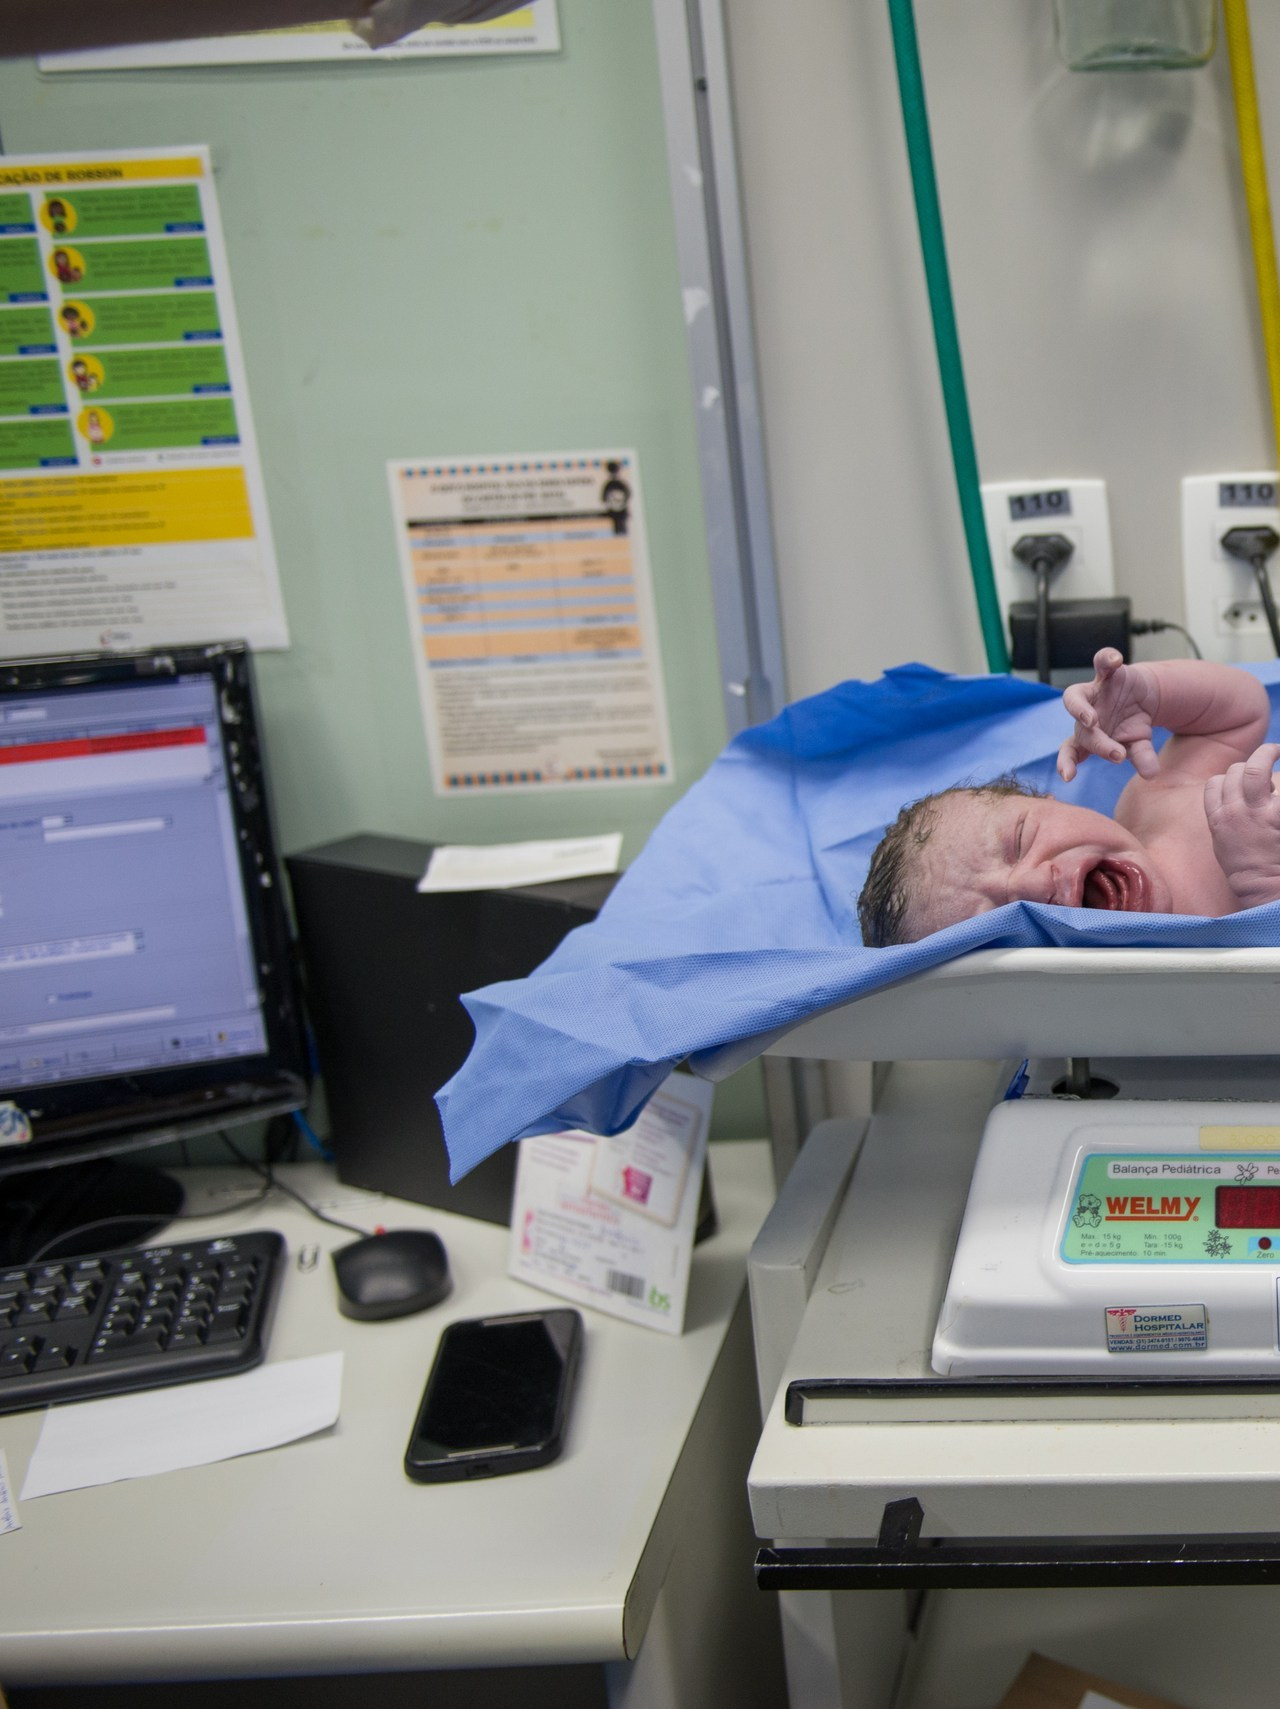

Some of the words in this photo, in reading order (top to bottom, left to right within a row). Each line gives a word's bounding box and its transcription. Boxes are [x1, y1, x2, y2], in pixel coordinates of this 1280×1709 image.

[1226, 482, 1274, 499] 110
[1012, 494, 1063, 513] 110
[1112, 1164, 1159, 1176] Balança
[1161, 1164, 1222, 1175] Pediátrica
[1113, 1233, 1121, 1241] kg
[1133, 1314, 1182, 1323] DORMED
[1134, 1322, 1204, 1332] HOSPITALAR
[1109, 1342, 1205, 1351] www.dormed.com.br
